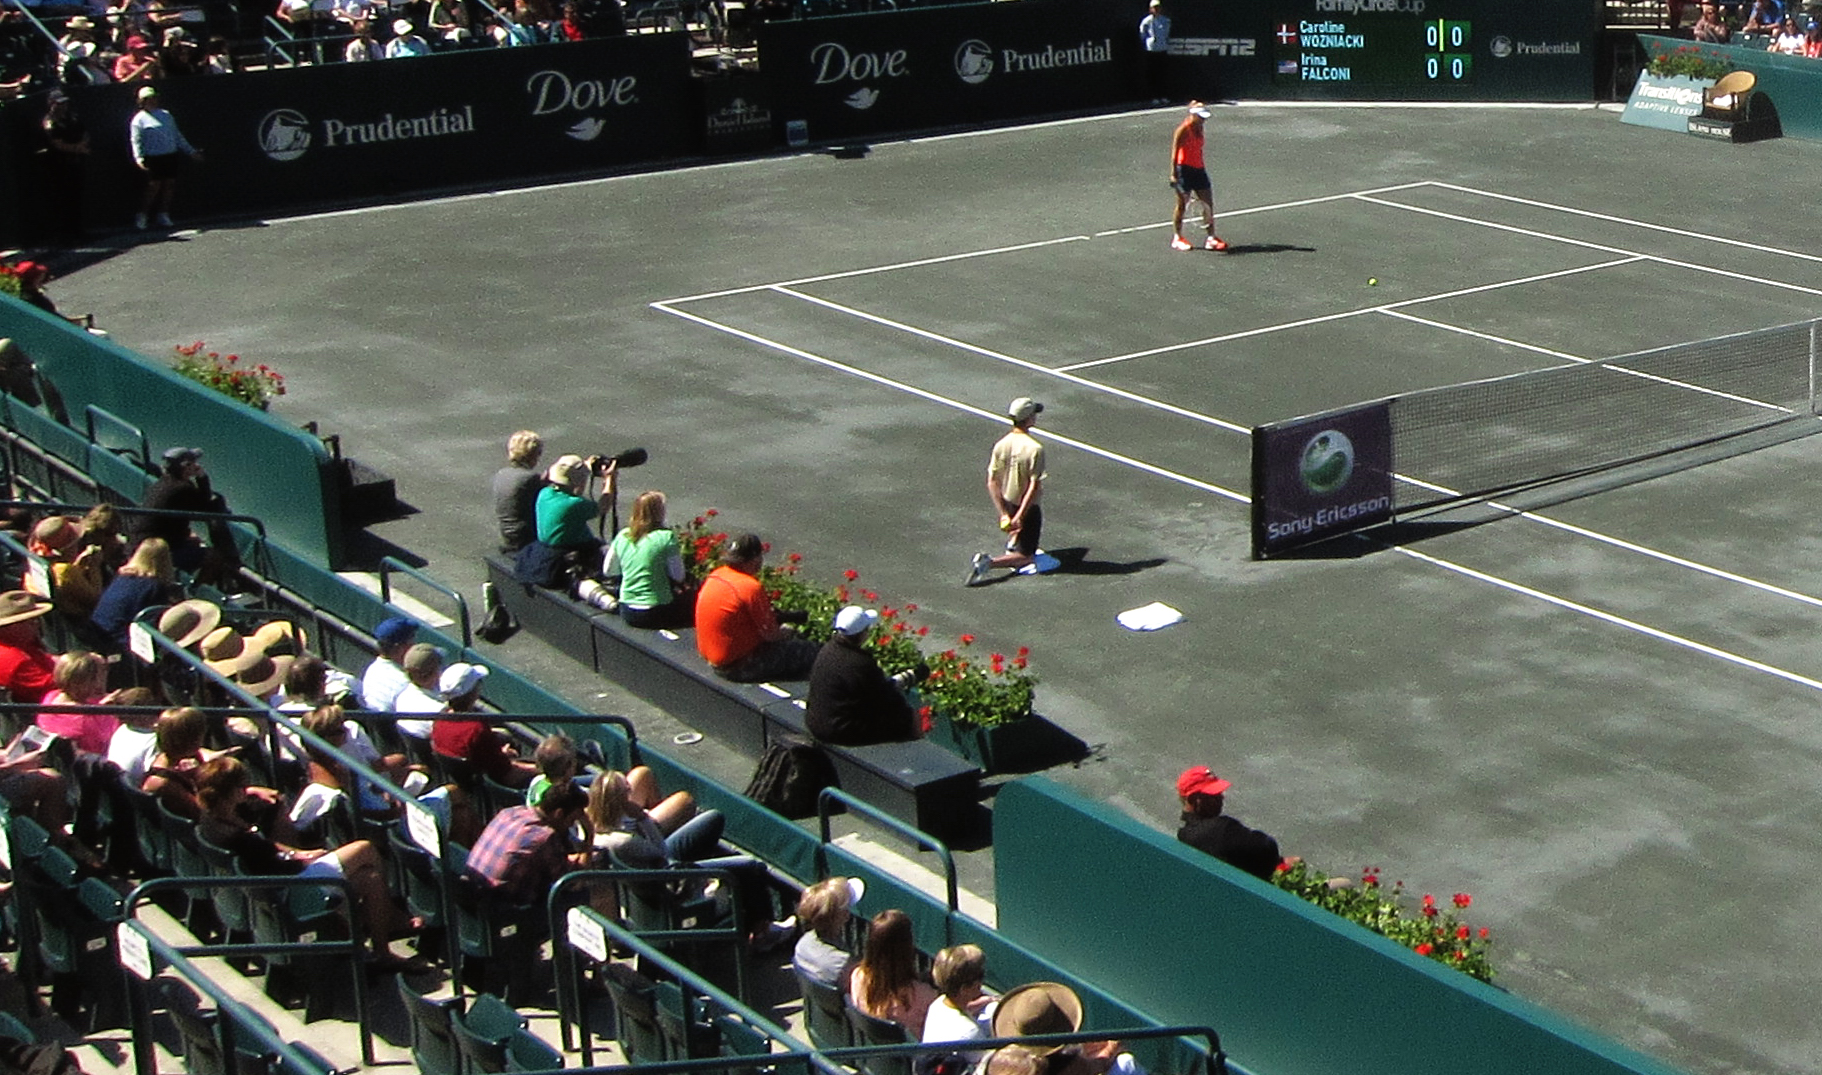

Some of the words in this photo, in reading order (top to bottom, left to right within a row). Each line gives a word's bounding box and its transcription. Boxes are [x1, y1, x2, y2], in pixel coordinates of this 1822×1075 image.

[1300, 20, 1345, 33] Caroline
[1300, 35, 1364, 48] WOZNIACKI
[1427, 26, 1437, 46] 0
[1452, 26, 1462, 46] 0
[1003, 39, 1112, 73] Prudential
[1167, 37, 1257, 56] ESPN2
[1517, 41, 1581, 55] Prudential
[811, 43, 905, 84] Dove
[1302, 53, 1327, 66] Irina
[1302, 67, 1351, 80] FALCONI
[1428, 58, 1438, 79] 0
[1453, 58, 1463, 79] 0
[527, 70, 635, 115] Dove
[325, 106, 474, 147] Prudential
[1268, 516, 1313, 540] Sony
[1316, 495, 1389, 525] Ericsson
